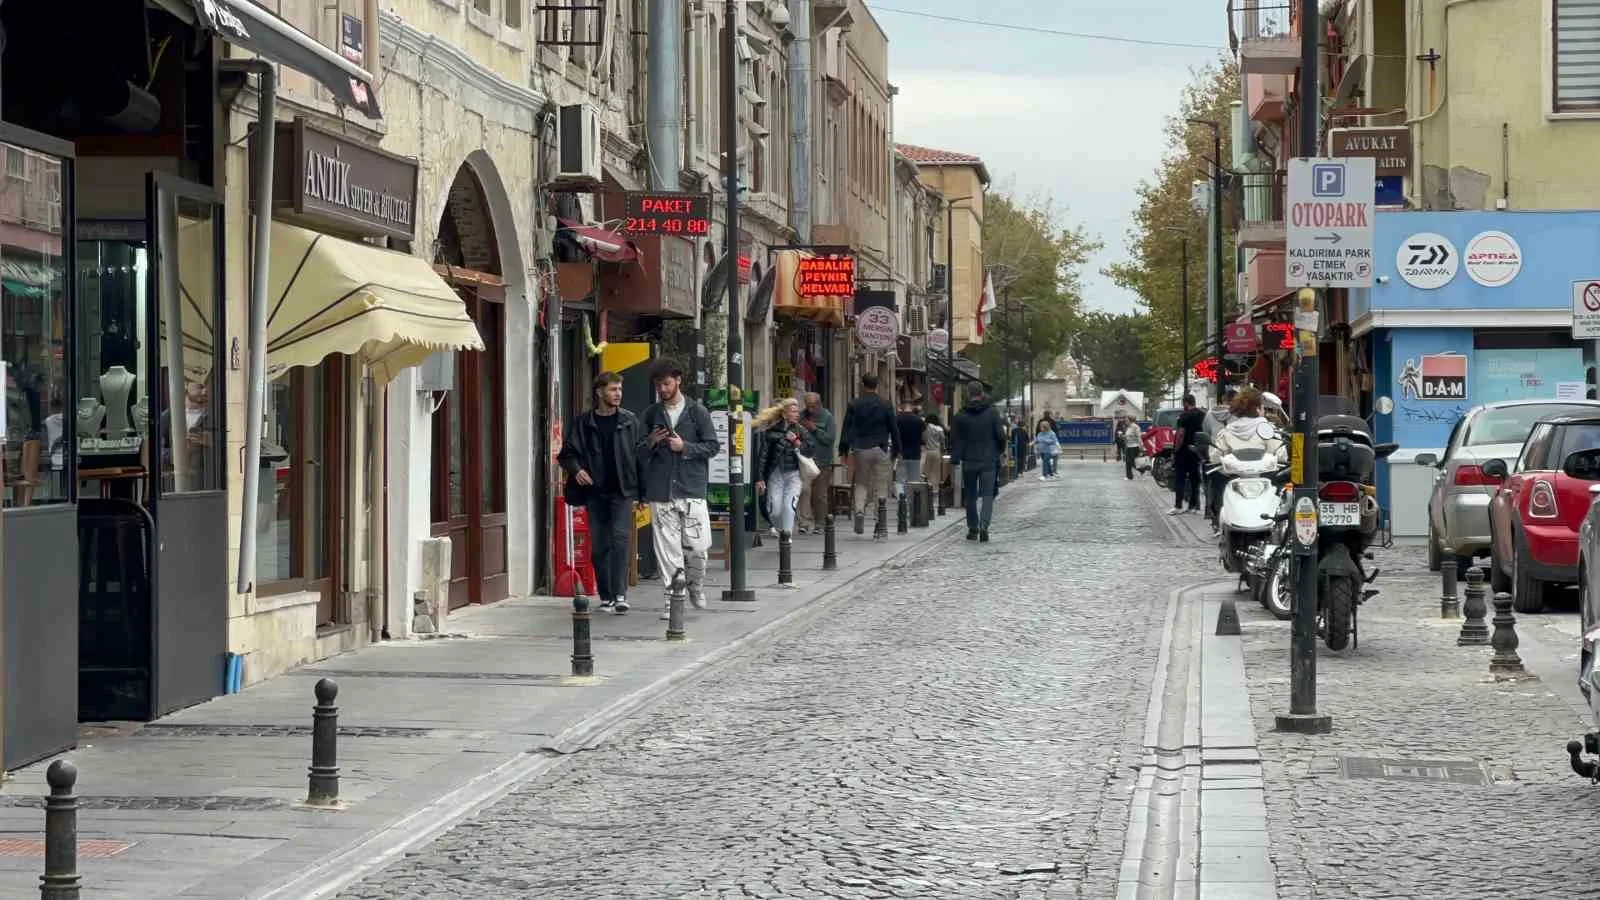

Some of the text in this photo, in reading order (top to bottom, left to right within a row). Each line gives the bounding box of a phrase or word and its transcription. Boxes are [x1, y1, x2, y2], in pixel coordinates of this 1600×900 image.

[1345, 136, 1397, 150] AVUKAT
[305, 144, 351, 208] ANTİK
[642, 199, 692, 213] PAKET
[1292, 202, 1367, 227] OTOPARK
[627, 218, 656, 231] 214
[1289, 249, 1370, 258] KALDIRIMA PARK
[1313, 260, 1346, 269] ETMEK
[869, 313, 889, 325] 33
[1322, 503, 1358, 514] 35 HB
